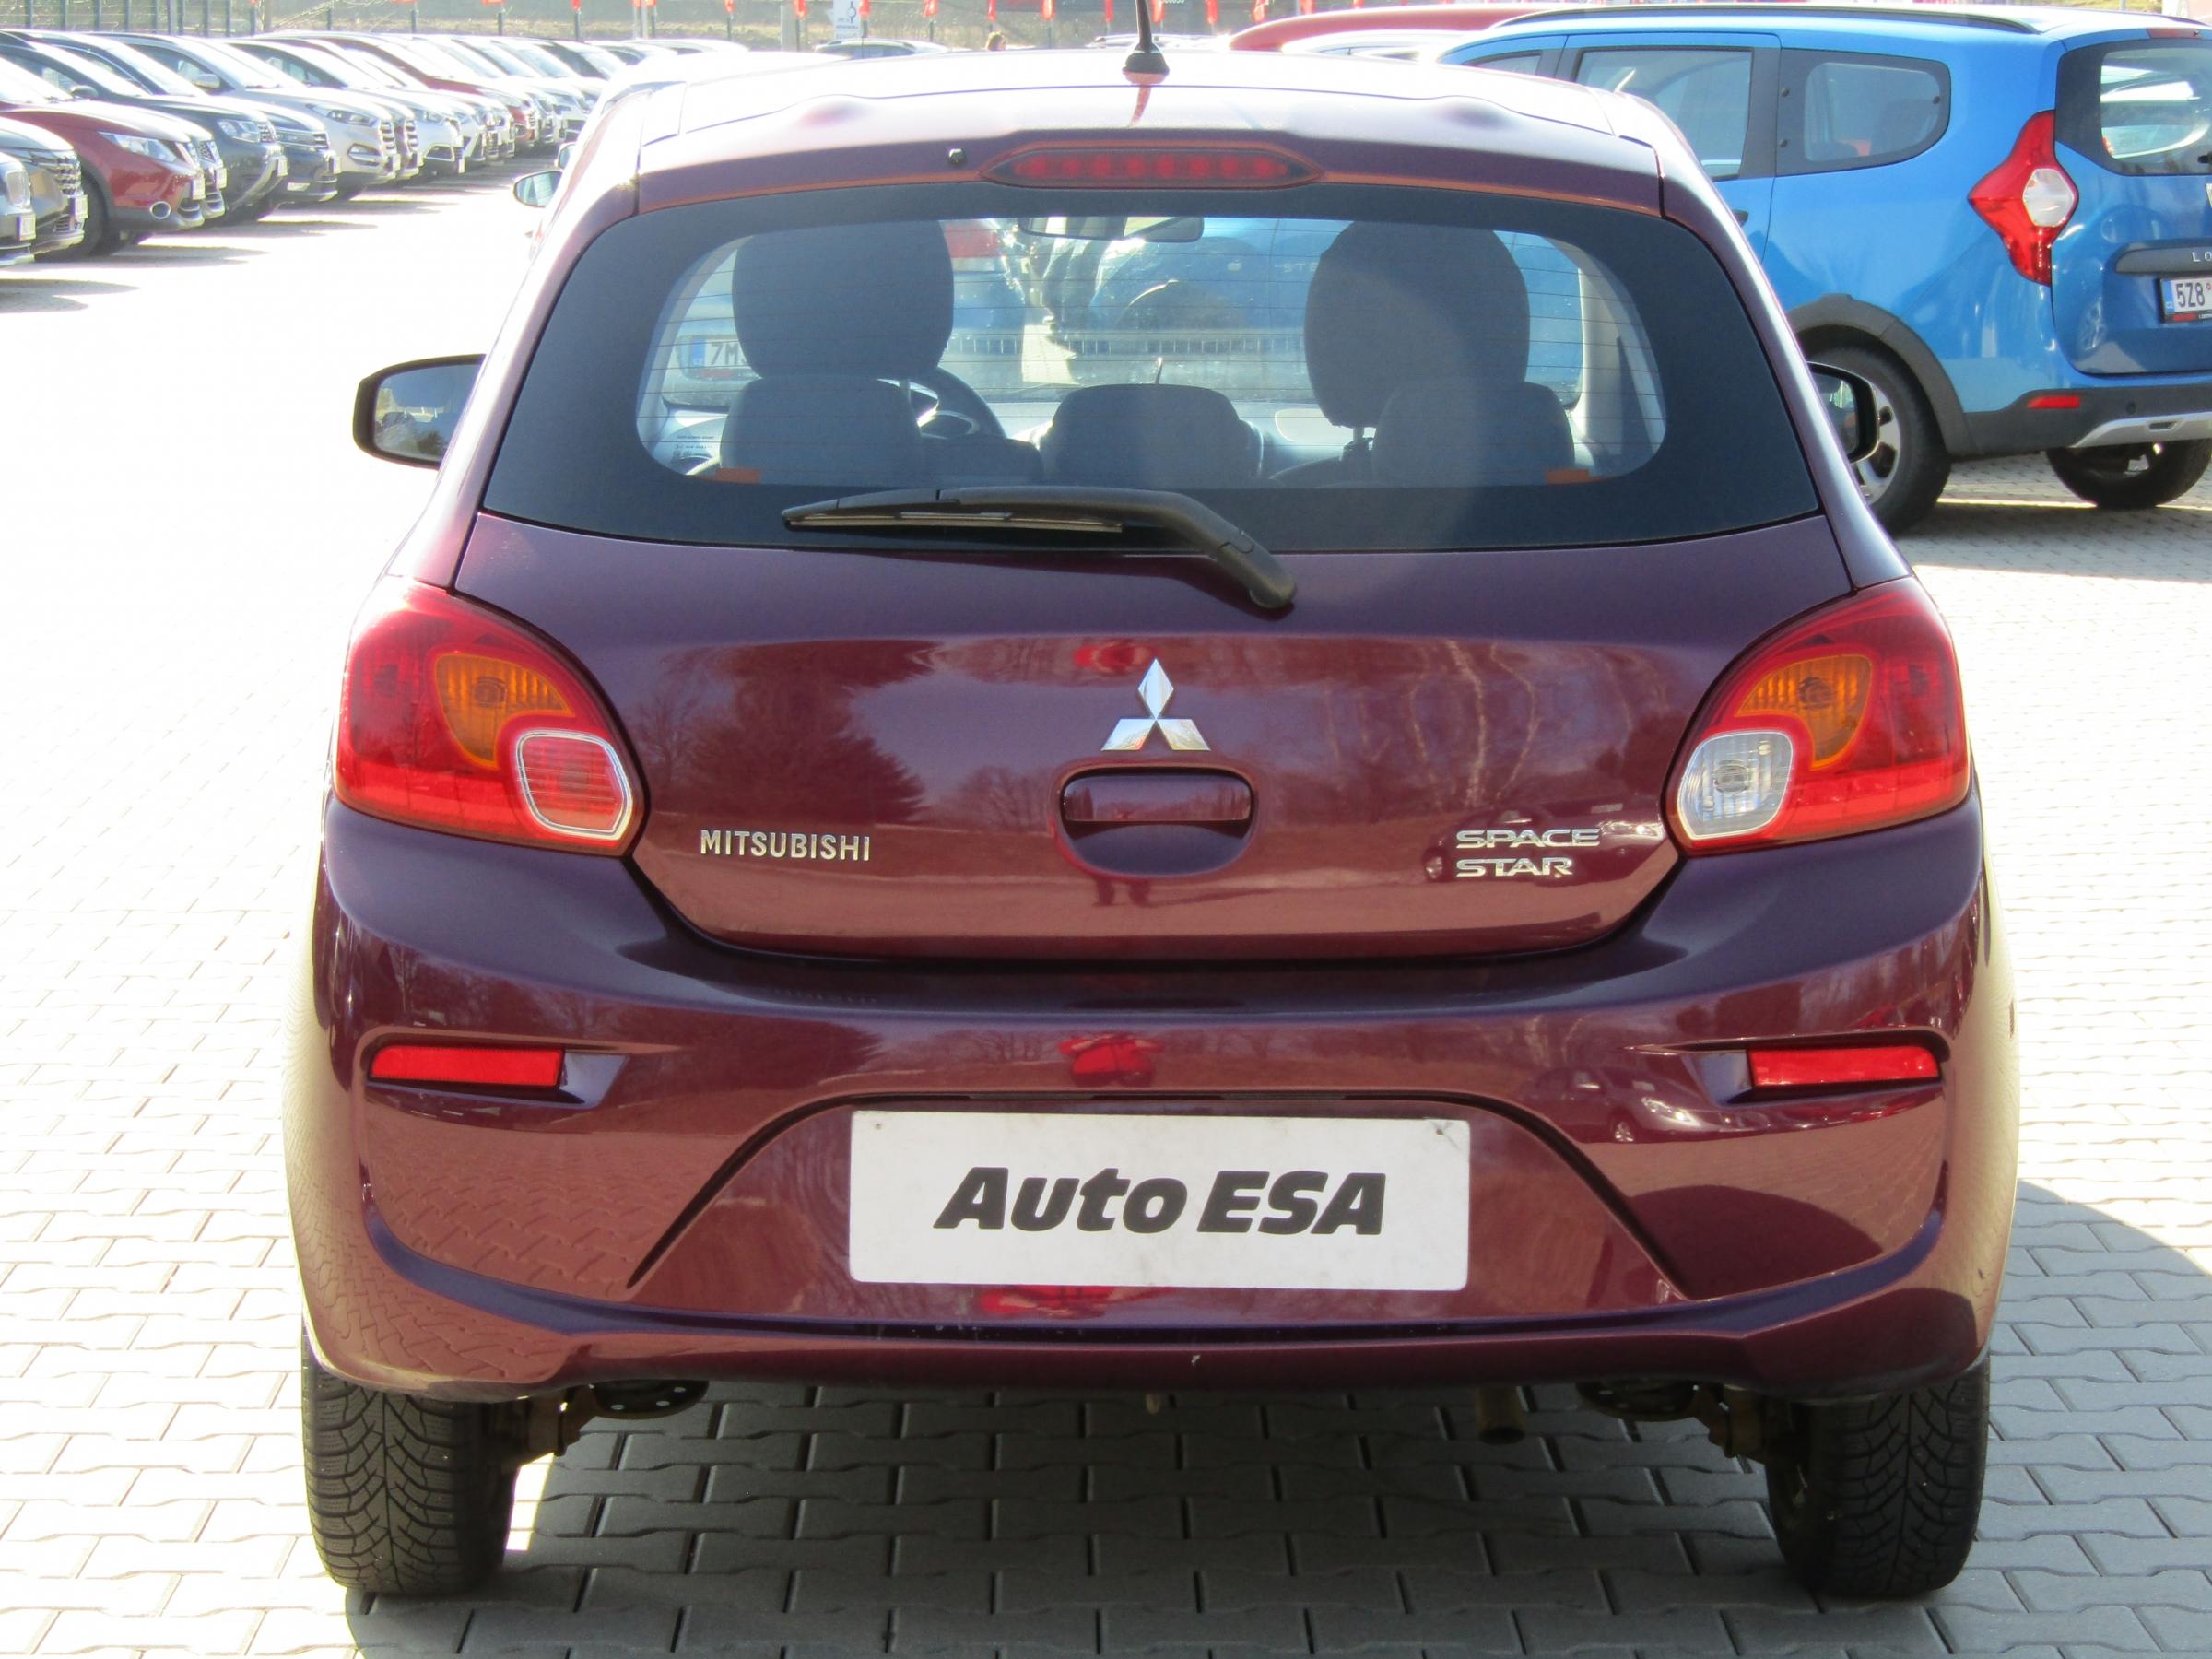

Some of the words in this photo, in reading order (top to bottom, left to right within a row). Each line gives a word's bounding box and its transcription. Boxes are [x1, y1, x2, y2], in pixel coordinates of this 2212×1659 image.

[2175, 282, 2205, 308] 5Z8
[711, 341, 749, 365] 7M
[700, 829, 871, 862] MITSUBISHI
[1455, 829, 1601, 849] SPACE
[1455, 857, 1573, 877] STAR
[932, 1166, 1188, 1234] Auto
[1196, 1170, 1386, 1236] ESA
